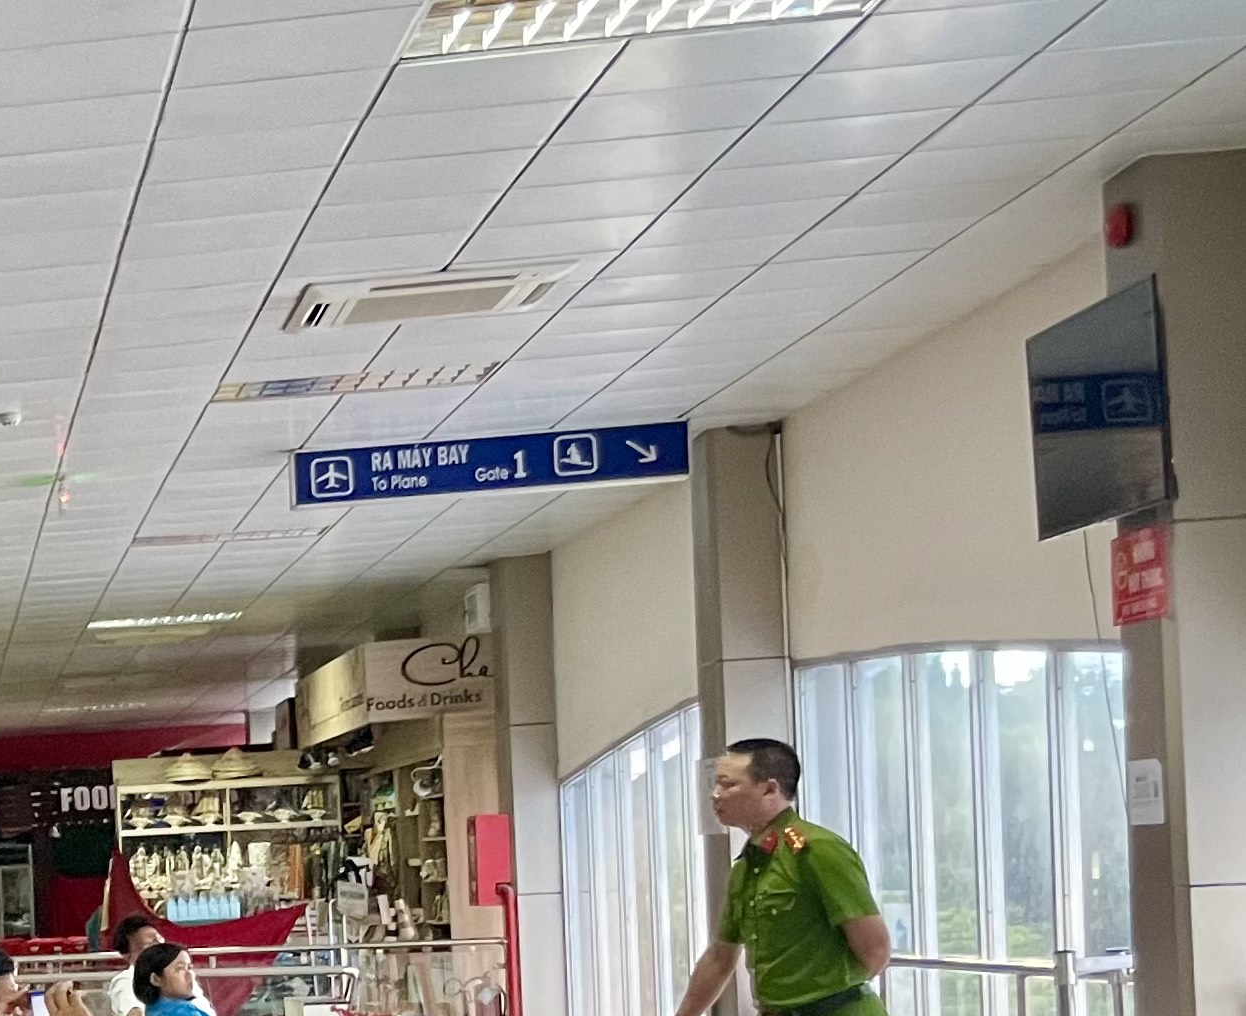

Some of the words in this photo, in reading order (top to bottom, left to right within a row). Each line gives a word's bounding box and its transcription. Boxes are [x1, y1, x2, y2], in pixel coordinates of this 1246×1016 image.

[371, 450, 393, 472] RA
[397, 444, 432, 470] MÁY
[437, 444, 470, 466] BAY
[475, 466, 509, 483] Gate
[513, 450, 527, 479] 1
[371, 475, 387, 492] To
[390, 474, 428, 490] Plane
[366, 693, 415, 712] Foods
[430, 687, 482, 705] Drinks
